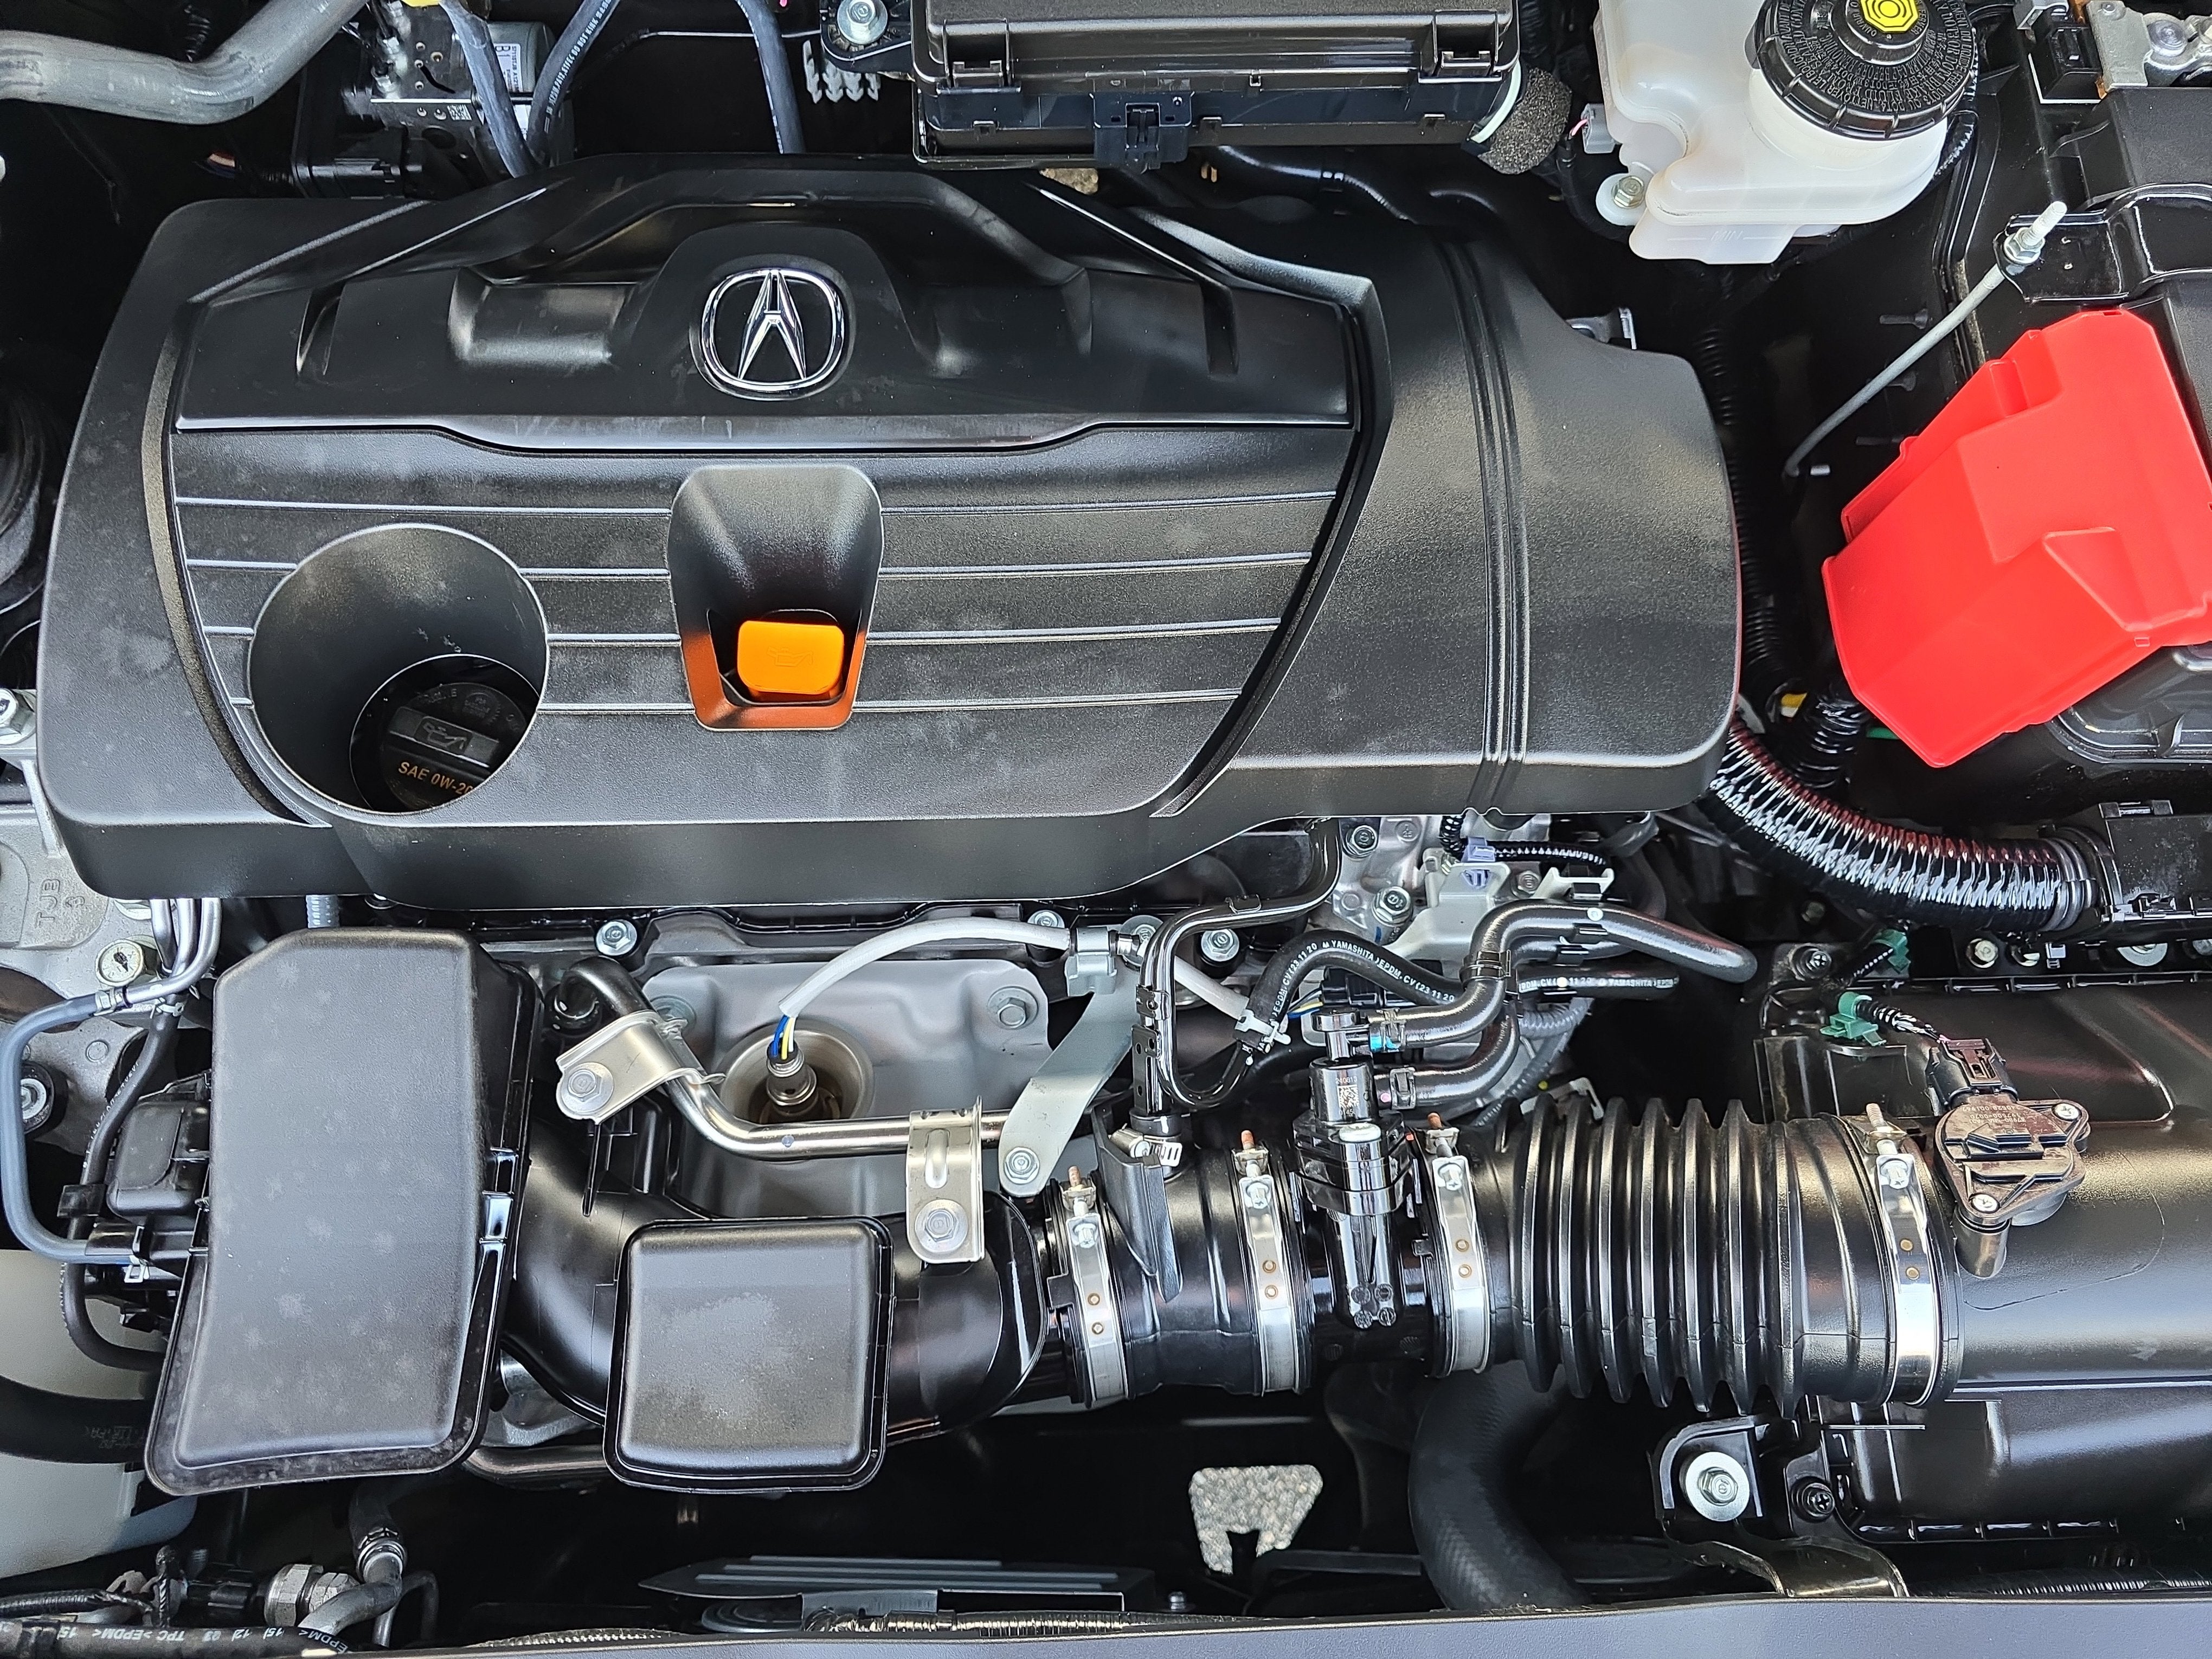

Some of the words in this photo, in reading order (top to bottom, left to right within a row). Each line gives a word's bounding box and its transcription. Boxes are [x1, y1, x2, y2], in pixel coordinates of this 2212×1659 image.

[577, 33, 588, 48] NOT
[586, 17, 599, 35] KINK
[495, 46, 510, 57] B1
[1827, 83, 1873, 110] NETTOYER
[1865, 89, 1902, 102] FLUID
[1904, 76, 1941, 99] BRAKE
[398, 762, 429, 780] SAE
[35, 878, 60, 928] TJB
[1307, 943, 1317, 953] 20
[1332, 940, 1374, 962] YAMASHITA
[1431, 989, 1441, 999] 11
[1443, 993, 1456, 1003] 20
[1609, 978, 1652, 987] YAMASHITA
[92, 1628, 153, 1641] >EPDM<
[157, 1630, 185, 1641] TPC
